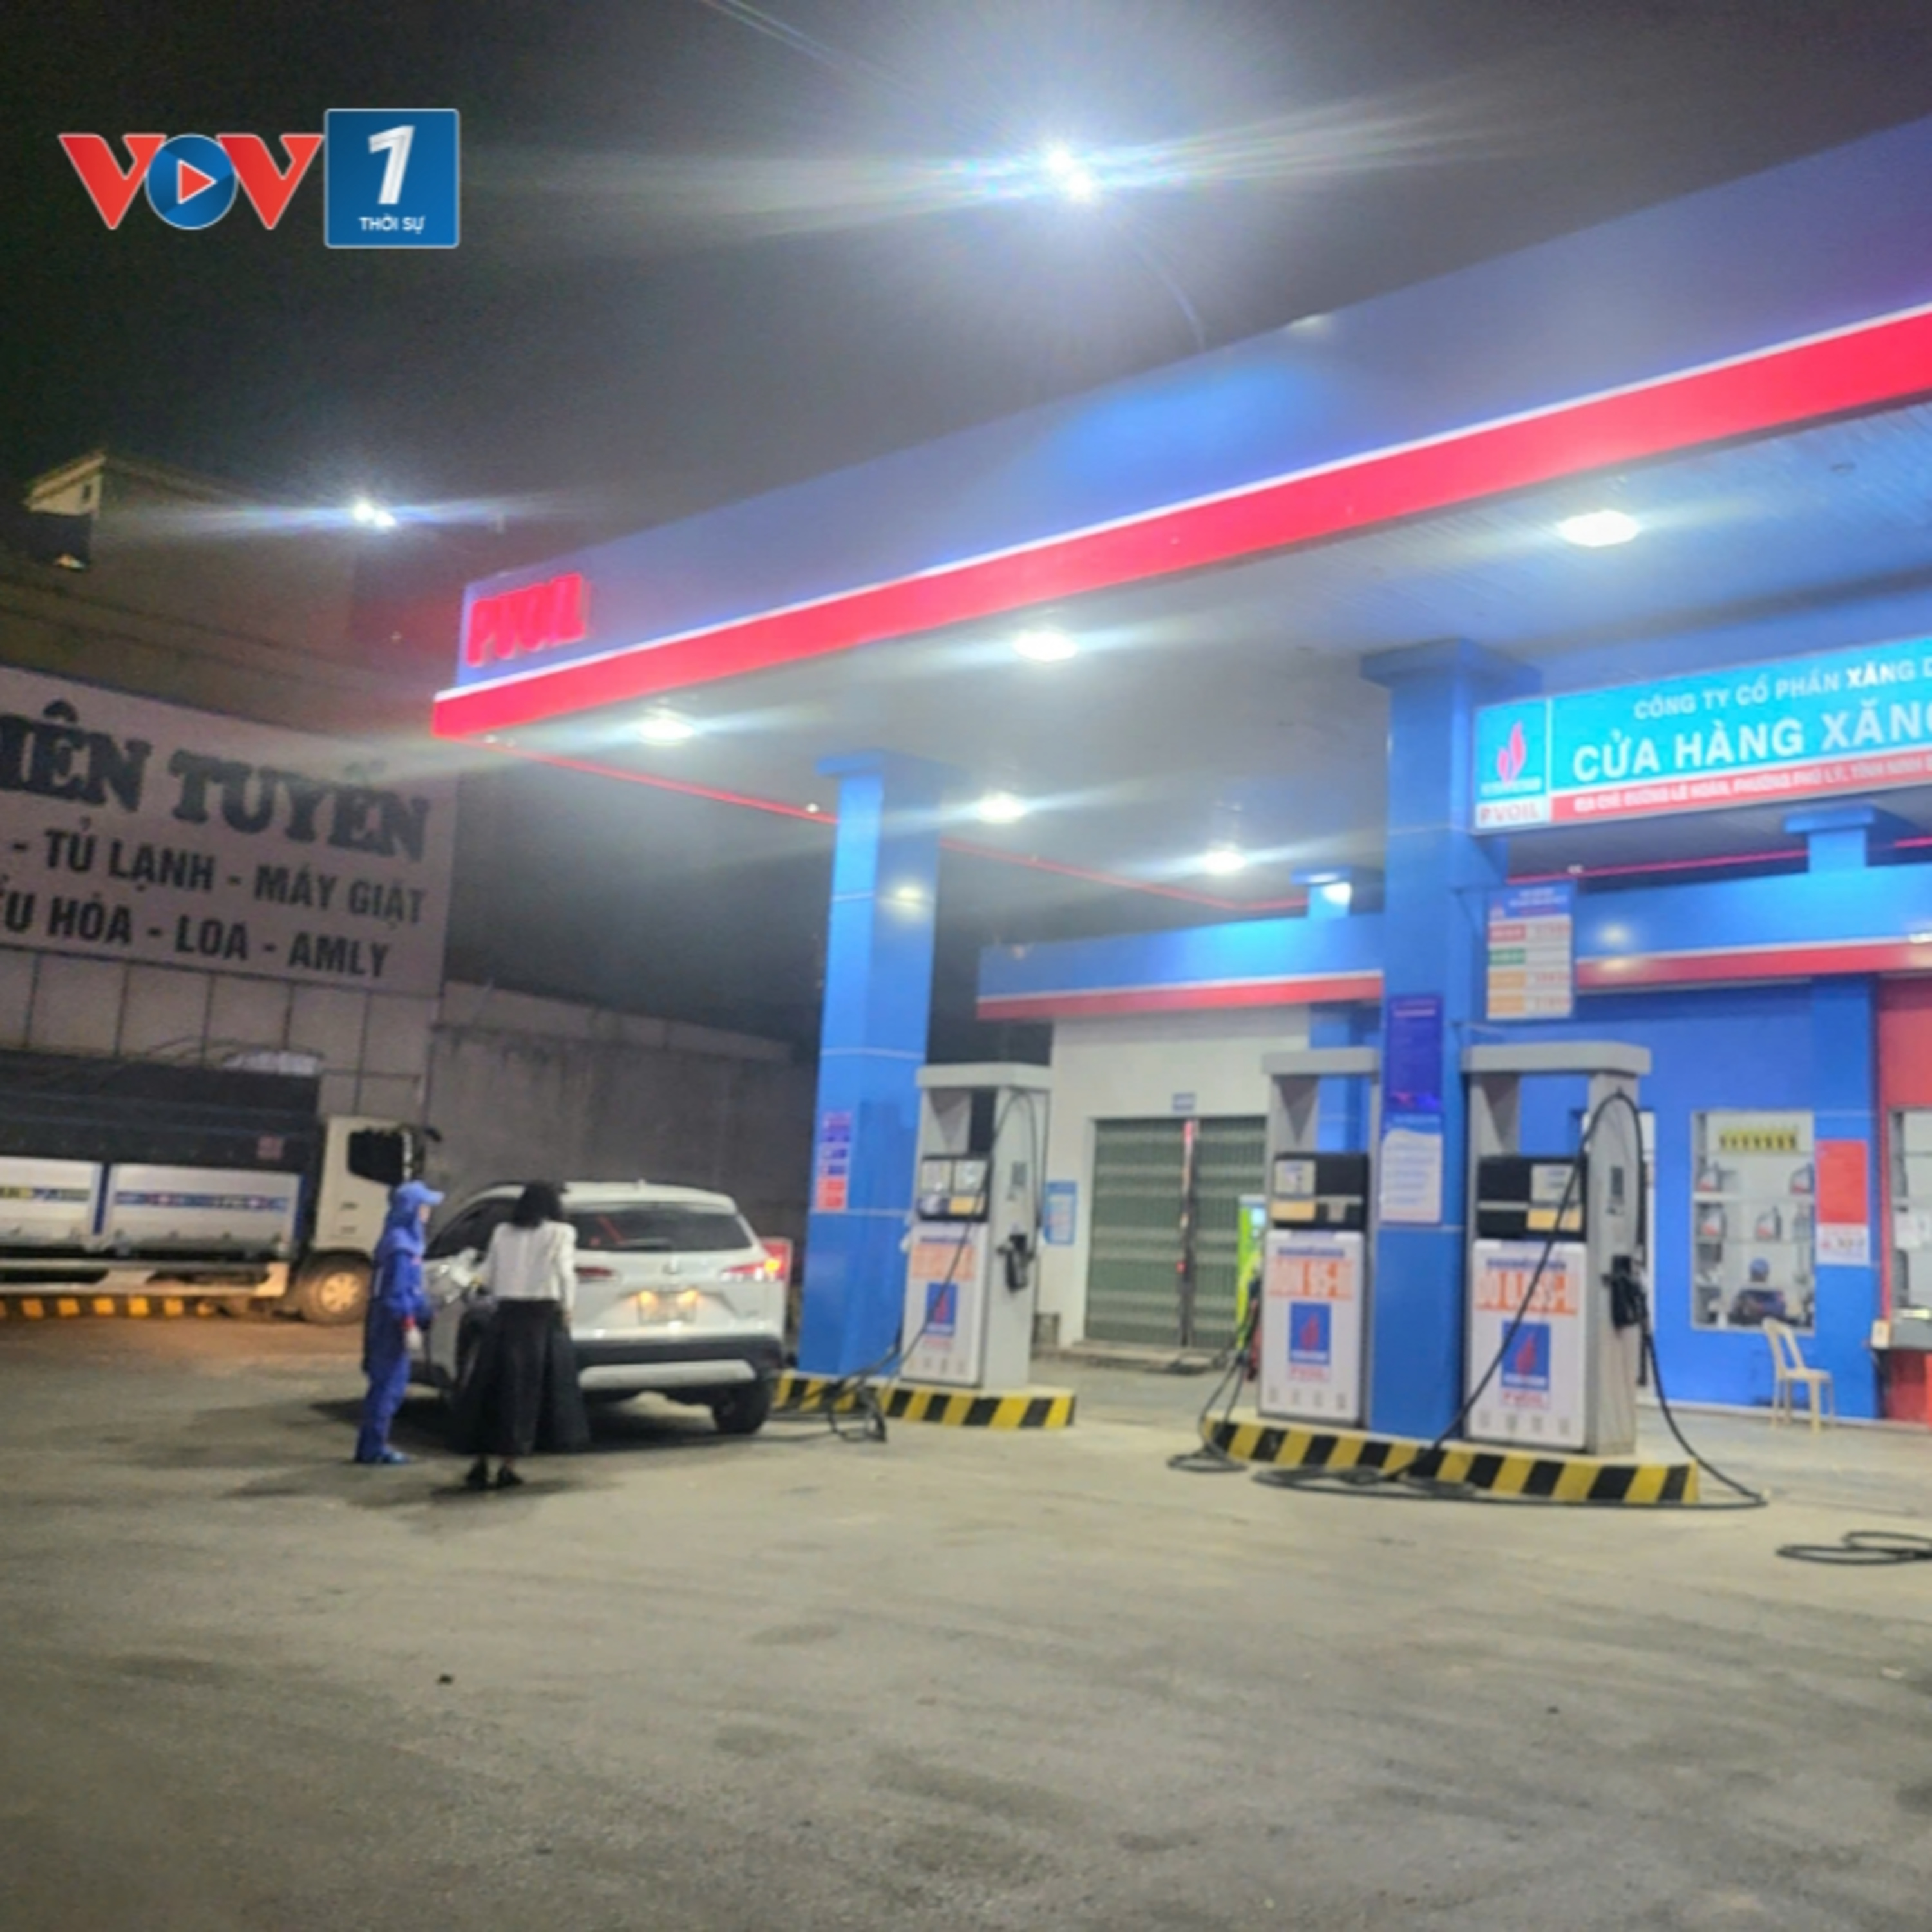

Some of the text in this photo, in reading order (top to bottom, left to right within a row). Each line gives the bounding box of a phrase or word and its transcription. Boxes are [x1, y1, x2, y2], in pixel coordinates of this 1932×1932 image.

[1573, 697, 1932, 782] CỬA HÀNG XĂN
[1634, 692, 1697, 720] CÔNG
[1702, 687, 1731, 709] TY
[45, 815, 96, 873] TỦ
[108, 840, 215, 892] LẠNH
[254, 864, 338, 911] MÁY
[175, 914, 248, 961] LOA
[289, 932, 390, 978] AMLY
